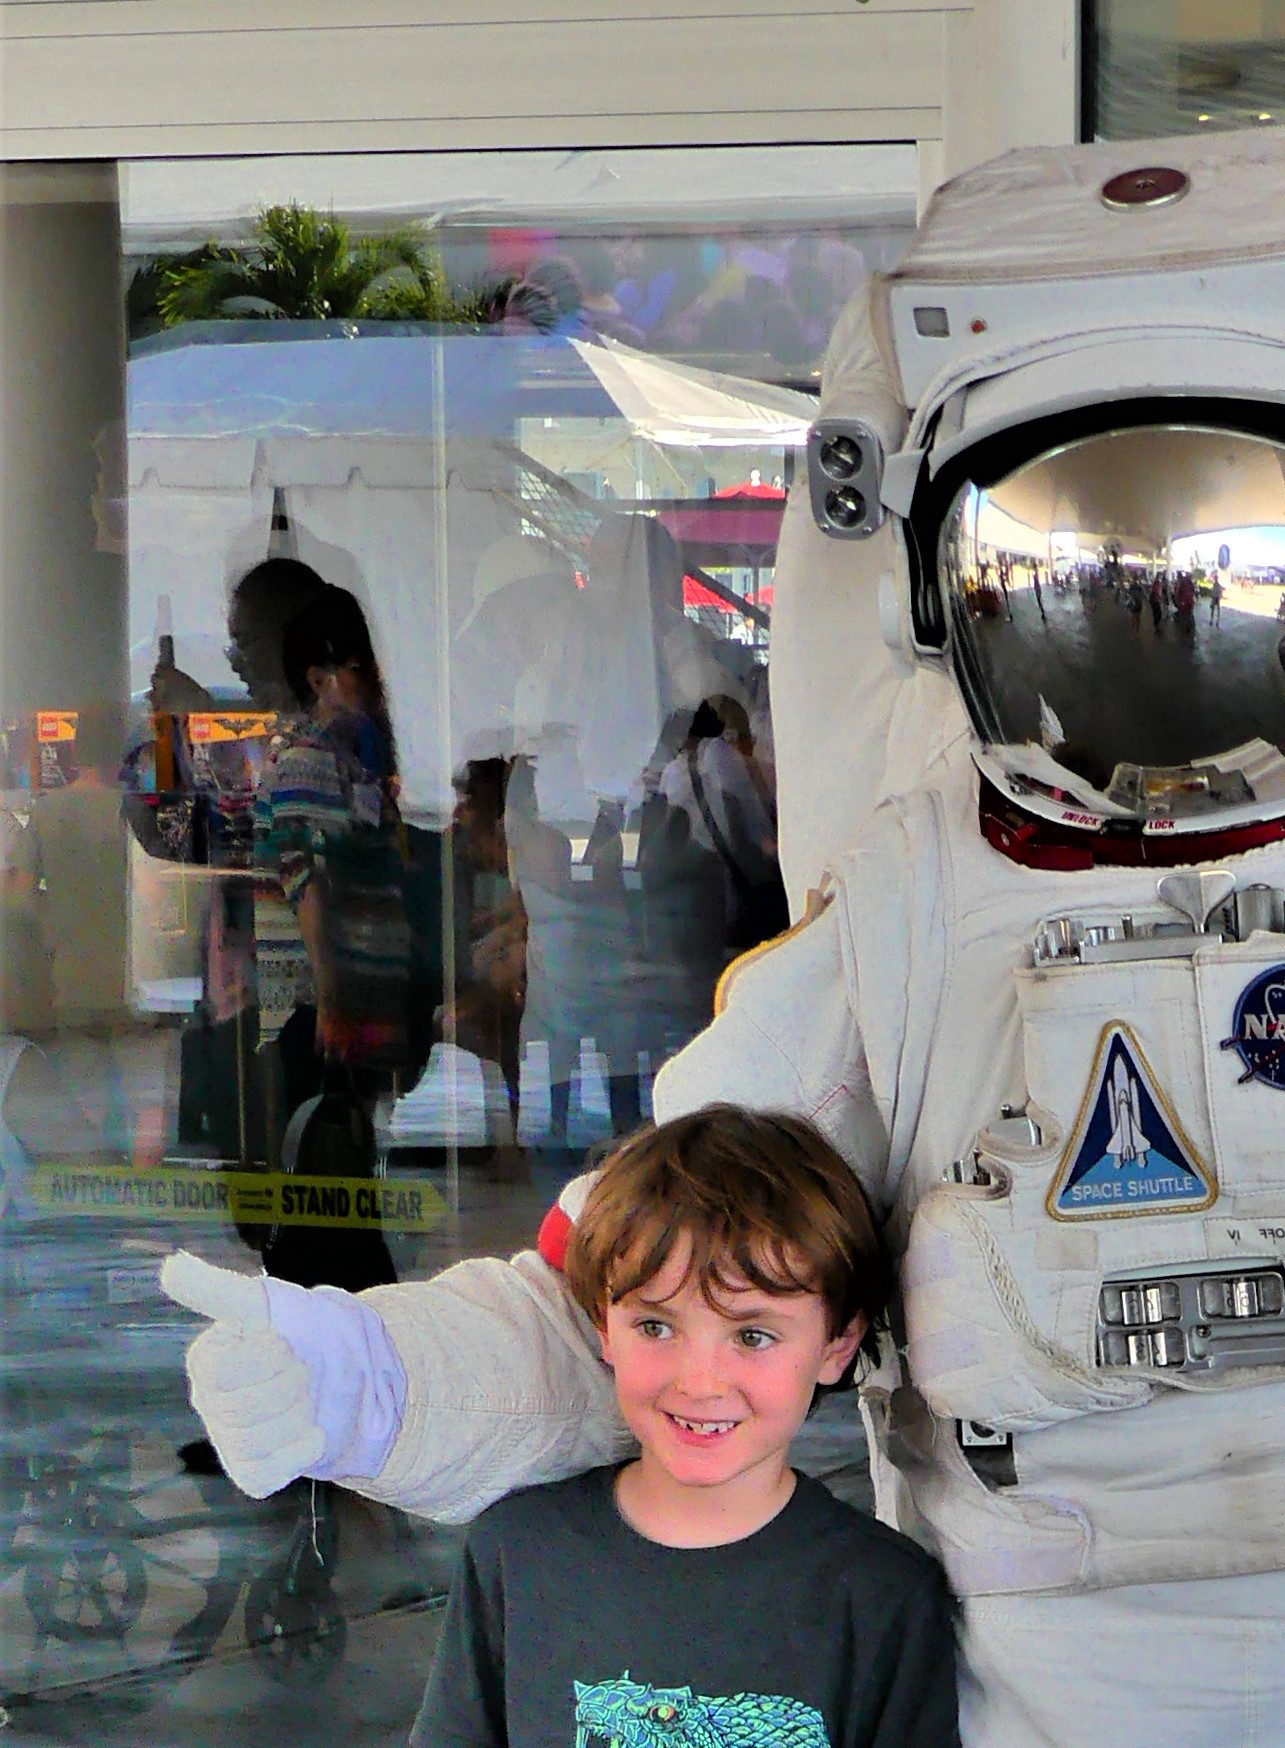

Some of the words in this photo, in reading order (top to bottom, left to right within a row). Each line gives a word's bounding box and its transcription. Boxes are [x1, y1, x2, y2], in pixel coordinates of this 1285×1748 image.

[1148, 820, 1175, 830] LOCK
[173, 1178, 228, 1210] DOOR
[281, 1184, 350, 1217] STAND
[355, 1187, 422, 1220] CLEAR
[1072, 1183, 1123, 1201] SPACE
[1127, 1176, 1193, 1197] SHUTTLE
